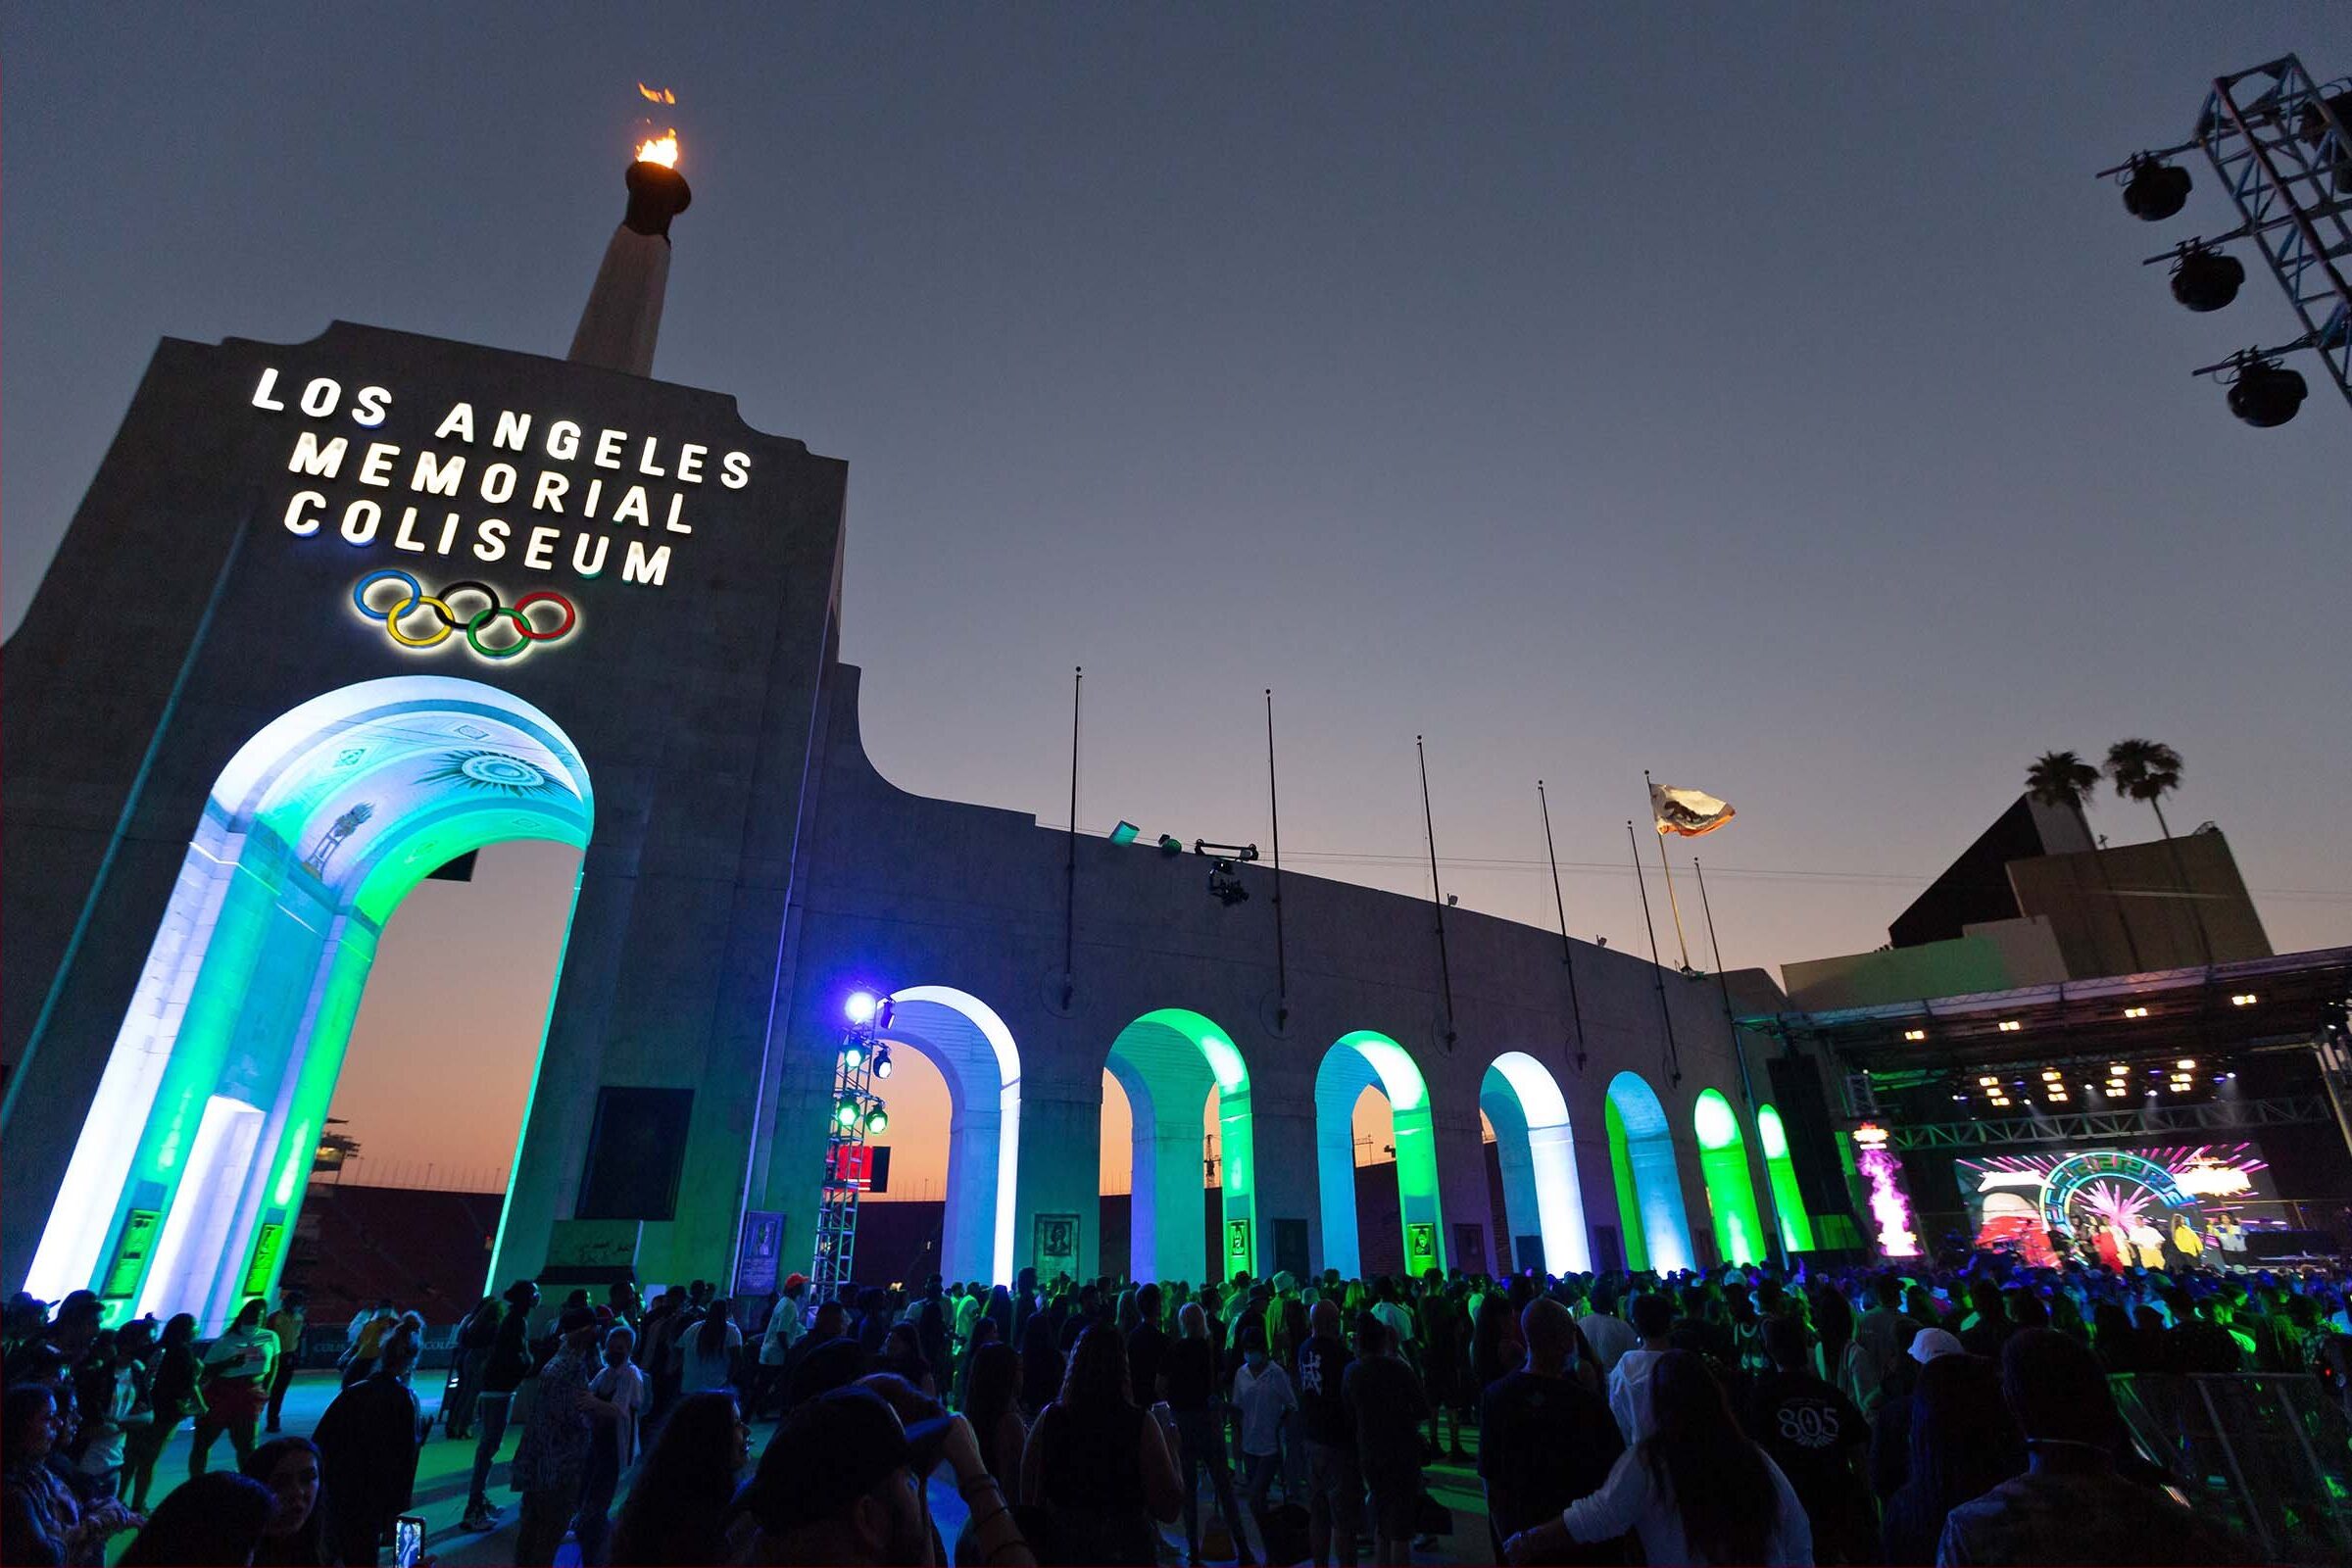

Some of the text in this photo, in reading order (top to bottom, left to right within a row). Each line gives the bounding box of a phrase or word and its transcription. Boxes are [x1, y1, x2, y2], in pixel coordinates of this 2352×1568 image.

[251, 368, 753, 490] LOS ANGELES
[288, 431, 693, 535] MEMORIAL
[283, 490, 671, 586] COLISEUM
[1776, 1406, 1840, 1440] 805
